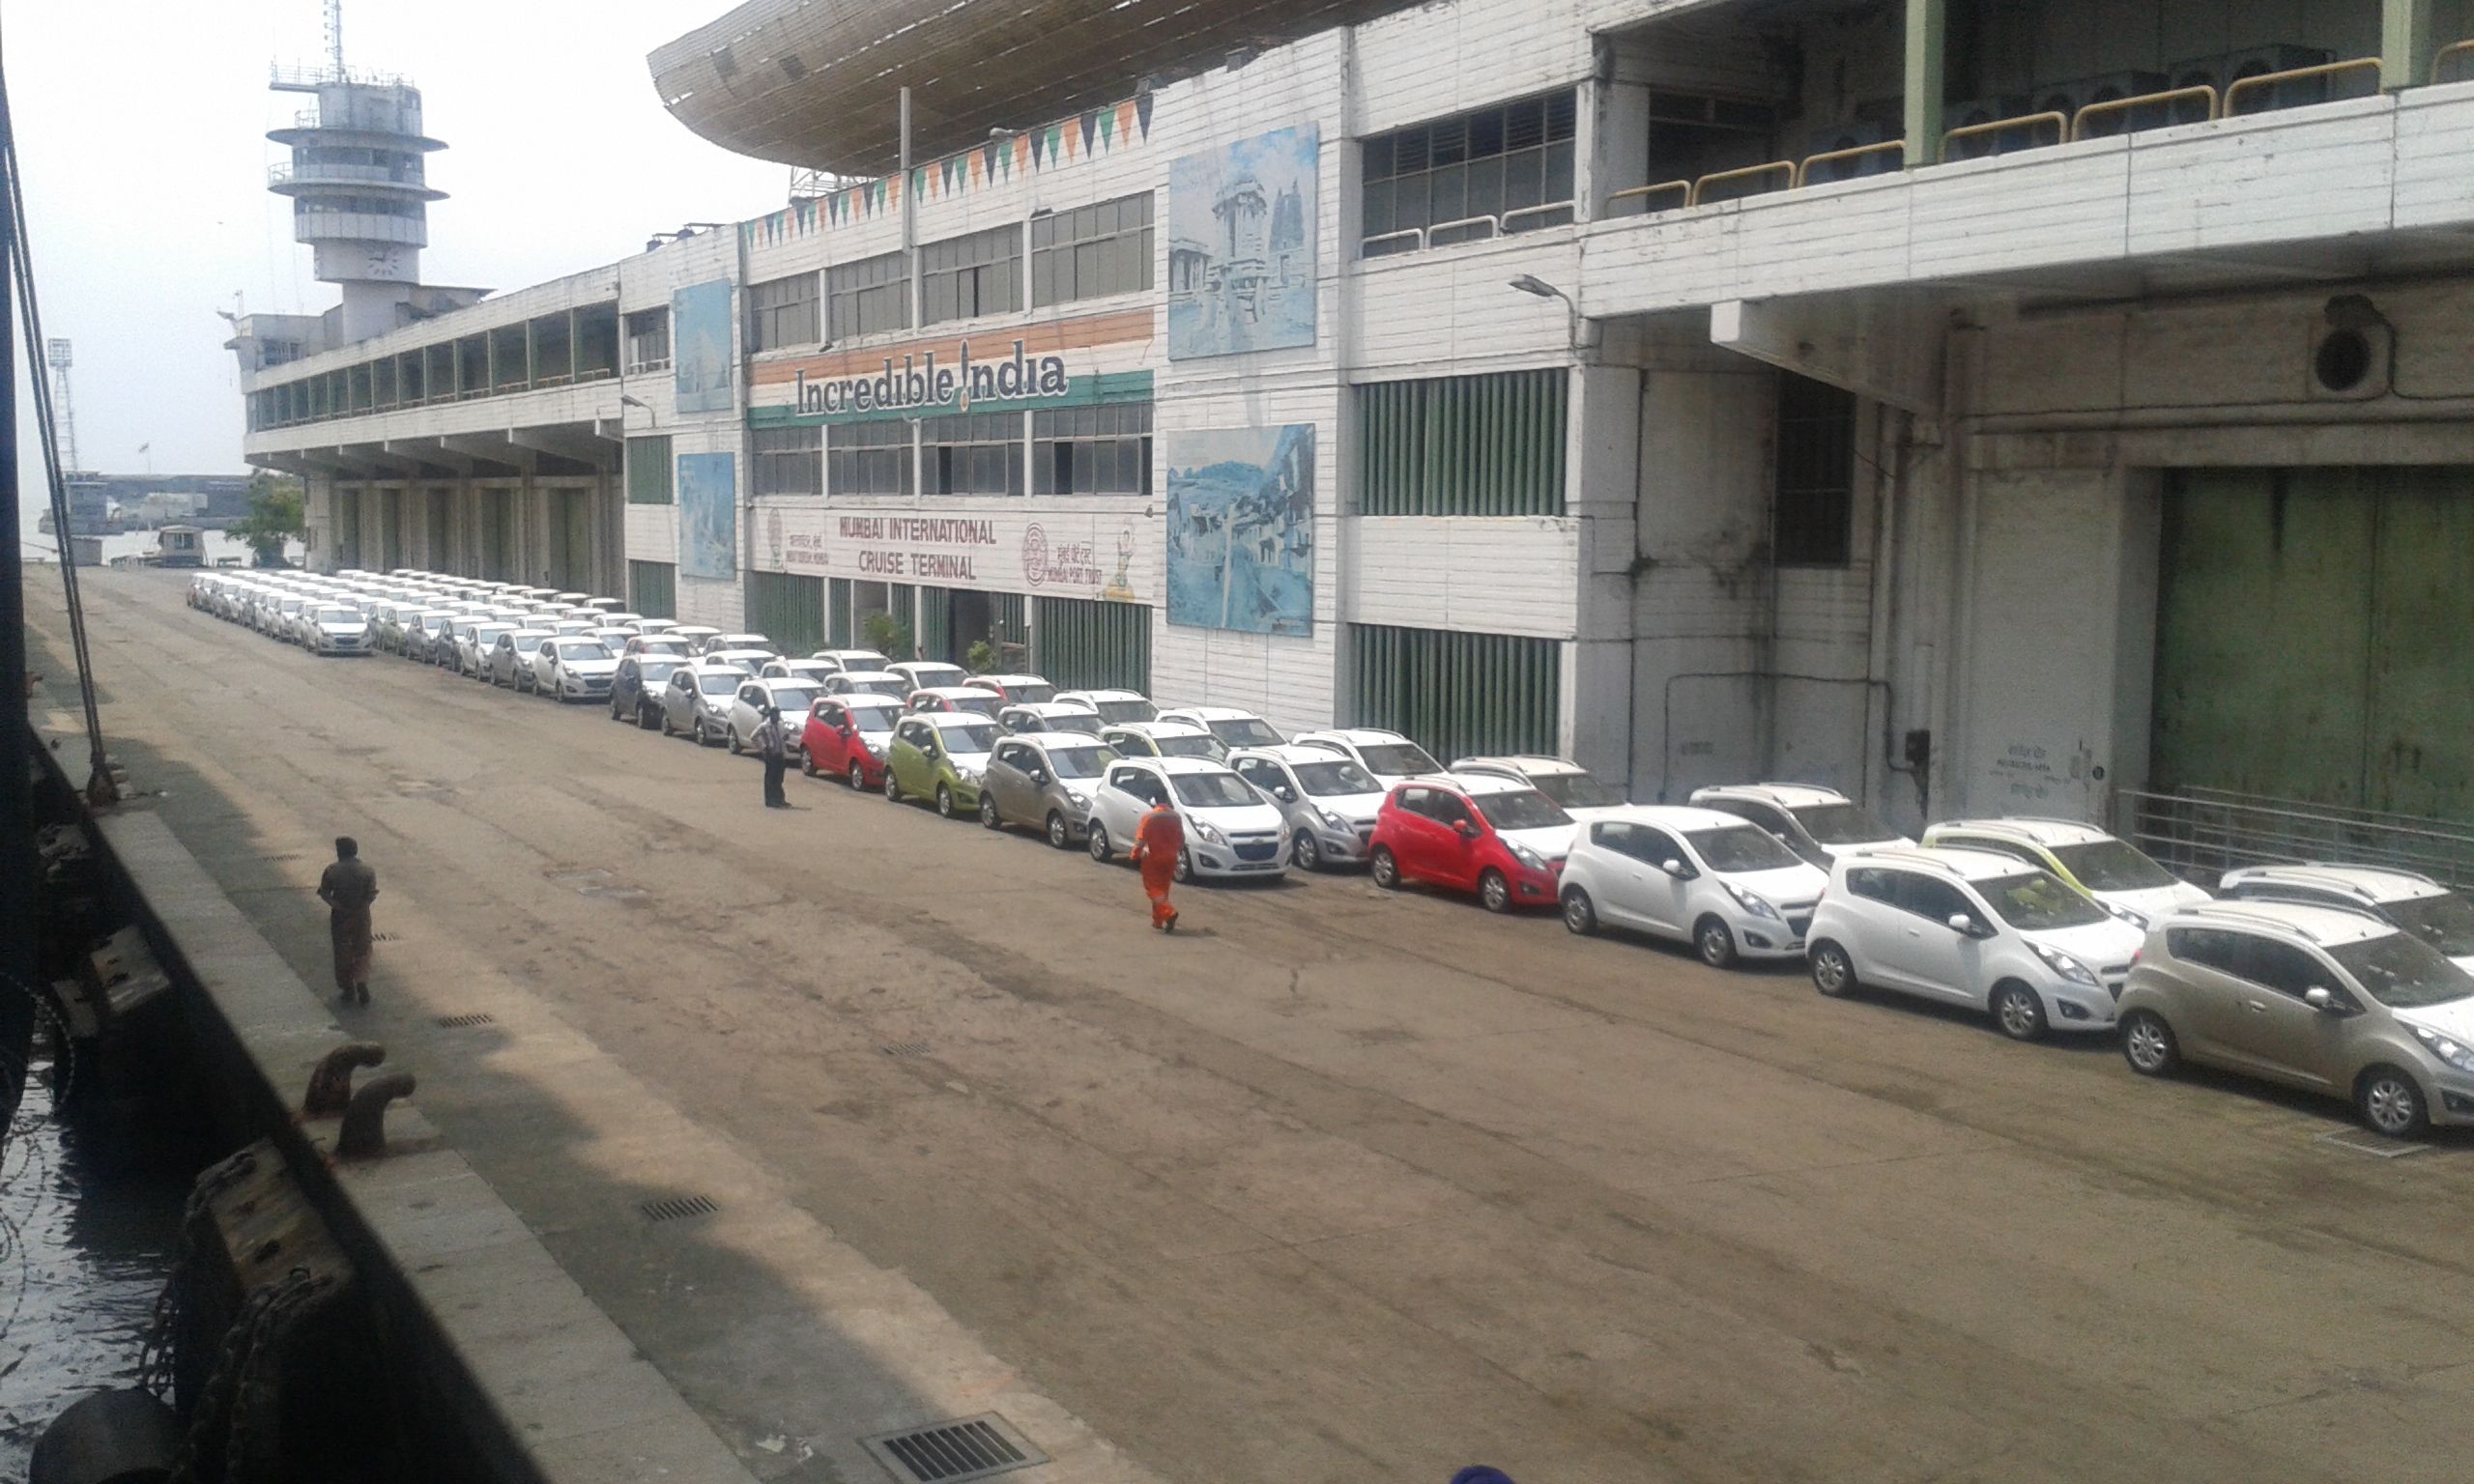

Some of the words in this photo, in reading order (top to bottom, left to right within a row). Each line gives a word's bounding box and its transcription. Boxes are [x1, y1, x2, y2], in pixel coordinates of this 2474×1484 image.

[795, 351, 954, 416] Incredible
[839, 516, 883, 540] MUMBAI
[889, 517, 996, 544] INTERNATIONAL
[858, 550, 904, 574] CRUISE
[910, 553, 976, 580] TERMINAL
